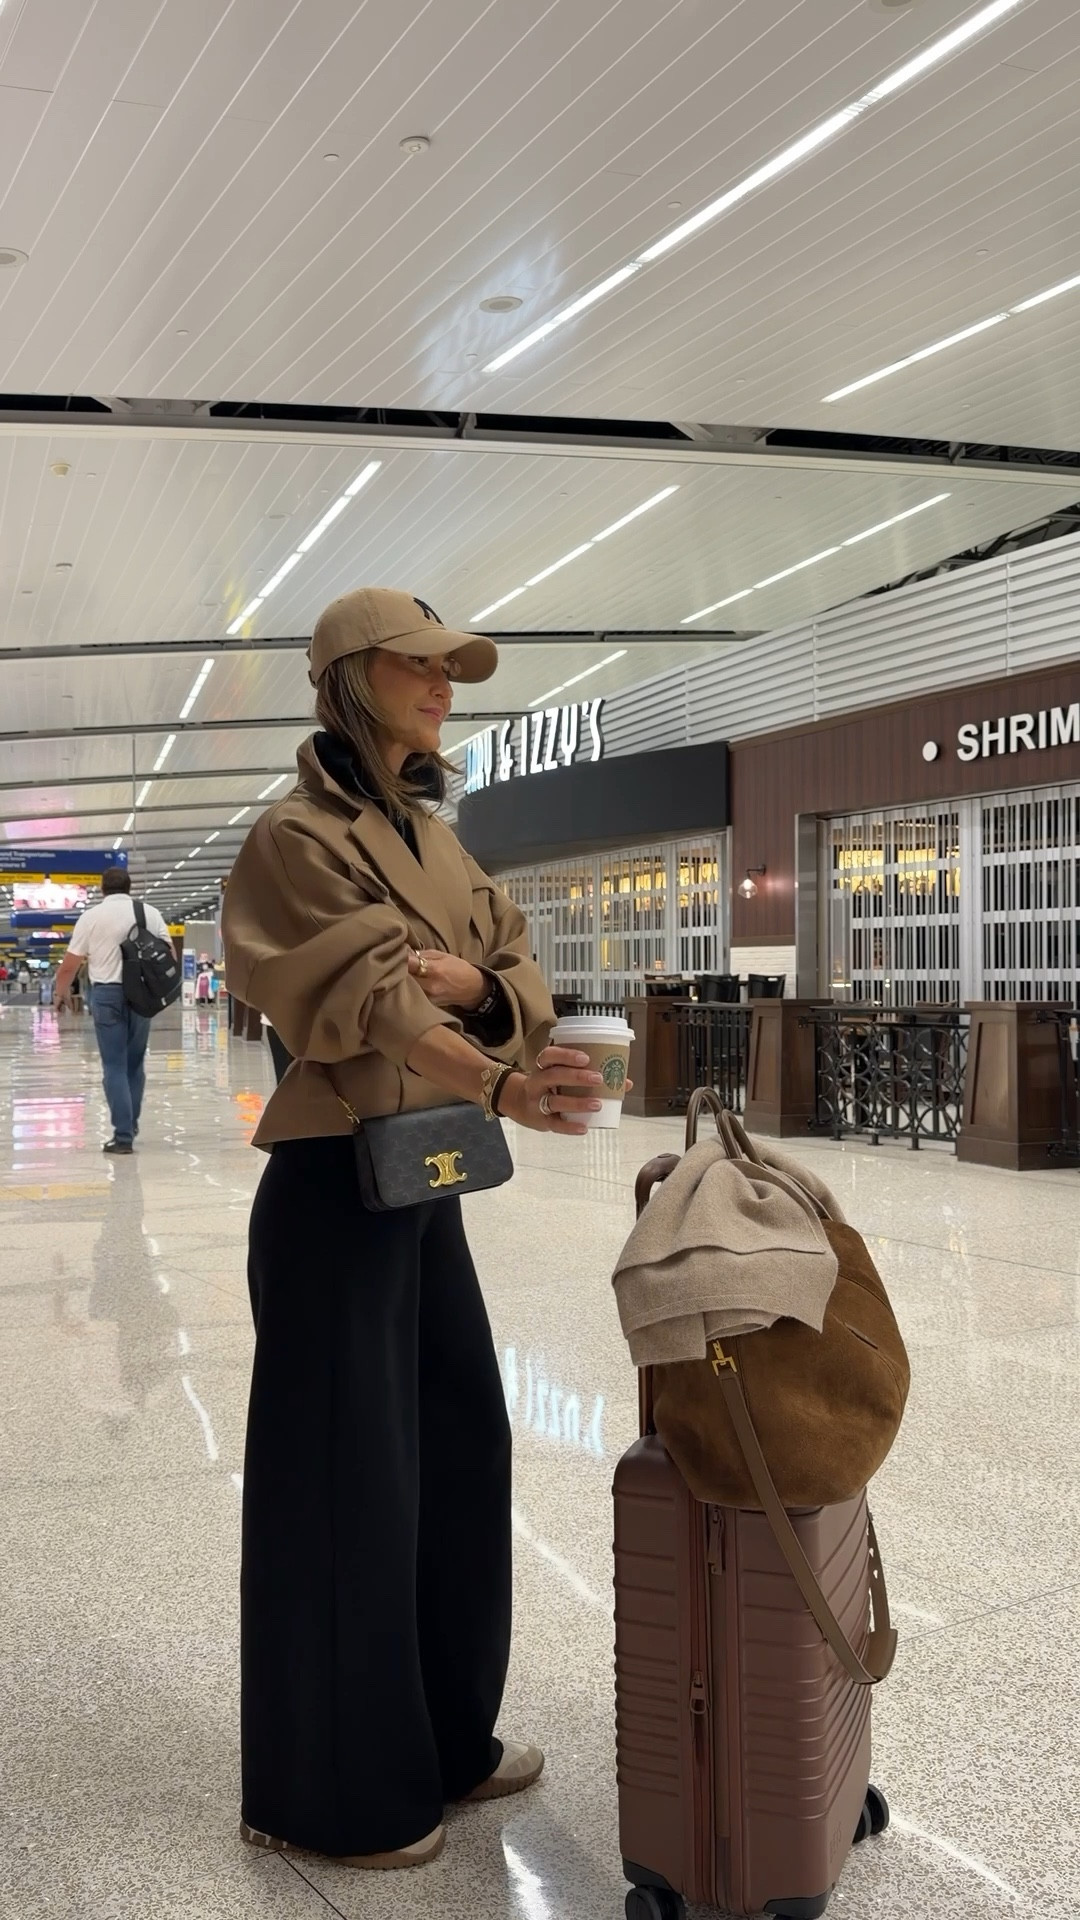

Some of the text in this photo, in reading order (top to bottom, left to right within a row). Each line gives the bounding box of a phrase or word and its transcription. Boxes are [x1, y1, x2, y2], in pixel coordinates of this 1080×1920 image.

[500, 719, 514, 782] &
[520, 697, 602, 777] IZZY'S
[957, 703, 1080, 761] SHRIM
